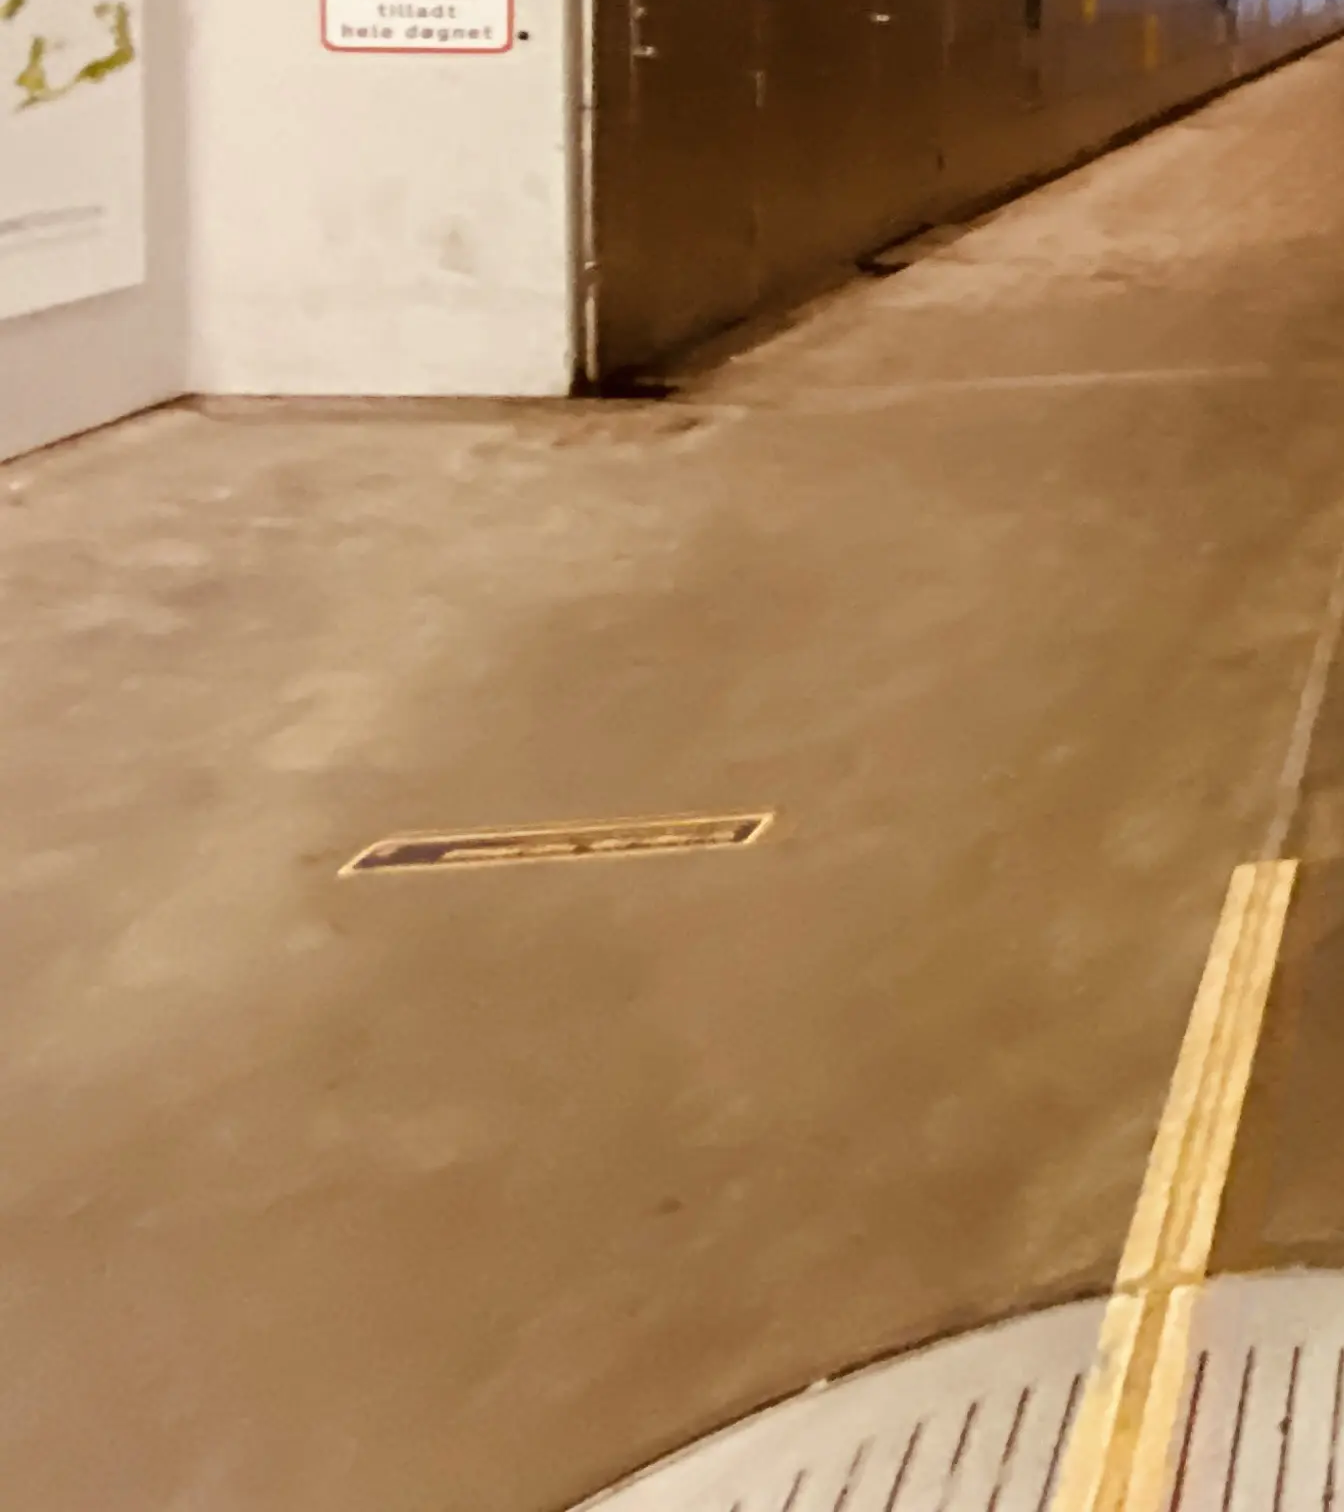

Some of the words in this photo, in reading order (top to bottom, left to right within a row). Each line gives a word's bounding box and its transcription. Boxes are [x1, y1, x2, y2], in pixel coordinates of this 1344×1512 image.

[377, 4, 456, 19] tilladt
[341, 24, 393, 39] hele
[405, 26, 493, 42] døgnet
